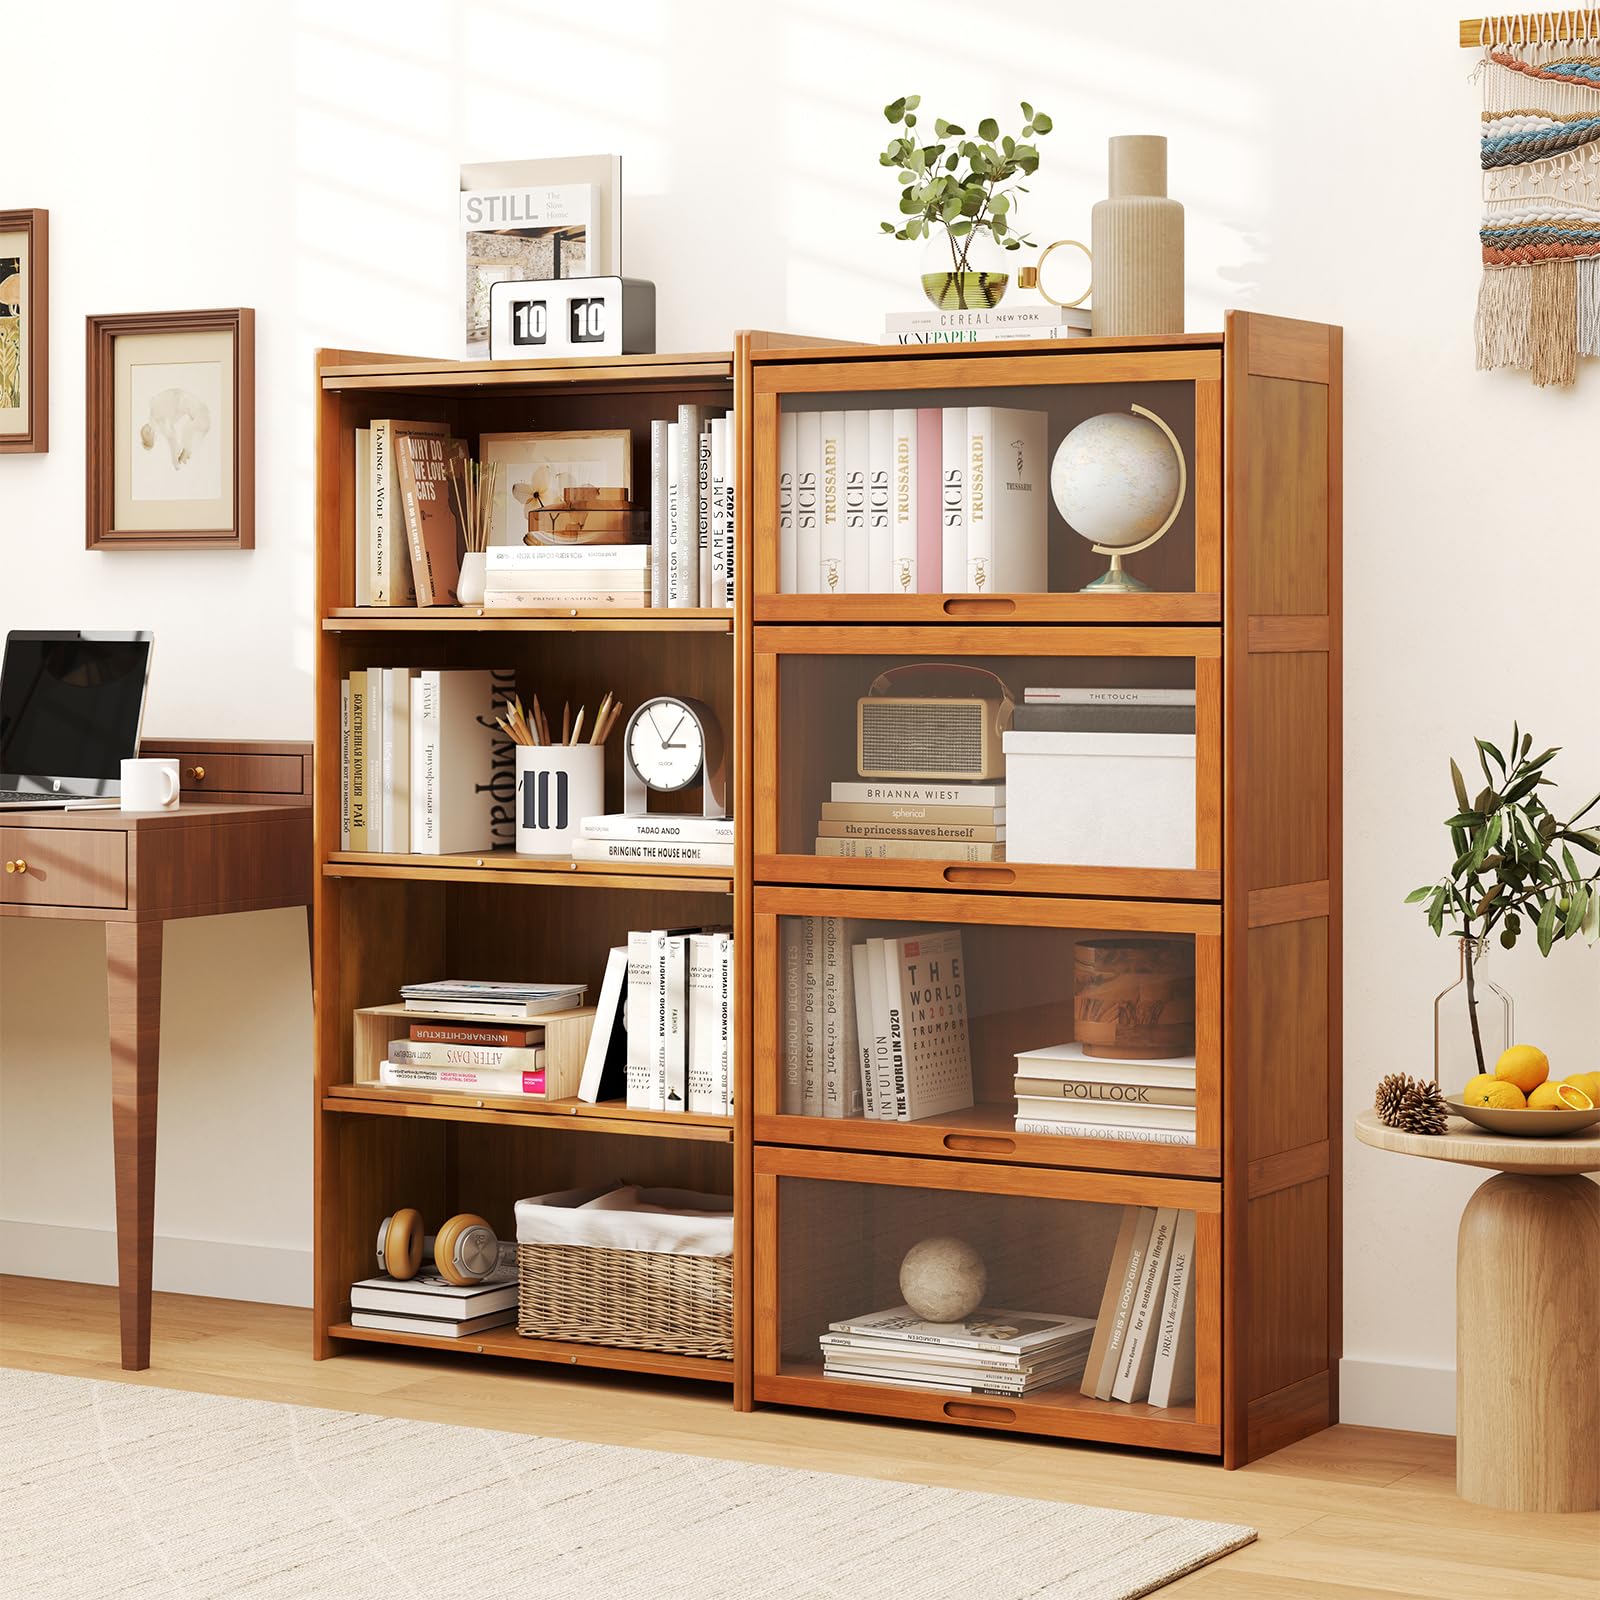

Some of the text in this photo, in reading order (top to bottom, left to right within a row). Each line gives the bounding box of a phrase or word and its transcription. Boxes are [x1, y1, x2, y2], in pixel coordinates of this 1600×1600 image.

[466, 194, 539, 223] STILL
[515, 302, 605, 338] 10 10
[941, 314, 990, 327] CEREAL
[1018, 313, 1040, 321] YORK
[376, 425, 385, 471] TAMING
[408, 438, 429, 460] WHY
[430, 439, 443, 461] DO
[412, 461, 447, 481] WE LOVE
[825, 439, 837, 525] TRUSSARDI
[897, 437, 909, 524] TRUSSARDI
[972, 435, 984, 523] TRUSSARDI
[376, 487, 385, 520] WOLF
[416, 481, 436, 501] CATS
[681, 409, 691, 601] How to make an arrangement in the house
[699, 439, 711, 550] Interior design
[780, 473, 792, 529] SICIS
[798, 472, 816, 529] SICIS
[846, 472, 864, 528] SICIS
[870, 471, 888, 528] SICIS
[944, 469, 963, 527] SICIS
[408, 508, 415, 518] DO
[410, 517, 417, 529] WE
[714, 476, 724, 571] SAME SAME
[727, 520, 734, 533] IN
[413, 545, 421, 561] CATS
[669, 483, 678, 601] Winston Churchill
[353, 693, 365, 828] БОЖЕСТВЕННАЯ КОМЕДИЯ РАЙ
[343, 781, 349, 791] по
[519, 770, 568, 829] 10
[867, 789, 960, 800] BRIANNA WIEST
[891, 808, 926, 819] spherical
[637, 826, 681, 836] TADAO ANDO
[845, 824, 863, 834] the
[937, 827, 975, 838] herself
[608, 846, 701, 860] BRINGING THE HOUSE HOME
[908, 958, 960, 985] THE
[804, 972, 816, 1013] Design
[910, 984, 961, 1005] WORLD
[787, 945, 798, 1086] HOUSEHOLD DECORATES
[911, 1009, 925, 1022] IN
[417, 1030, 508, 1042] INNENARCHITEKTUR
[804, 1020, 814, 1073] Interior
[417, 1051, 432, 1060] SCOTT
[447, 1049, 503, 1064] AFTER DAYS
[889, 1009, 906, 1117] THE WORLD IN 2020
[804, 1079, 814, 1099] The
[875, 1036, 892, 1116] INTUITION
[1063, 1083, 1150, 1102] POLLOCK
[1055, 1126, 1190, 1145] NEW LOOK REVOLUTION
[1152, 1225, 1169, 1259] lifestyle
[1111, 1250, 1141, 1351] THIS IS A GOOD GUIDE
[1140, 1260, 1159, 1310] sustainable
[1139, 1310, 1146, 1318] a
[1161, 1252, 1186, 1358] DREAM the world AWAKE
[1134, 1318, 1143, 1331] for
